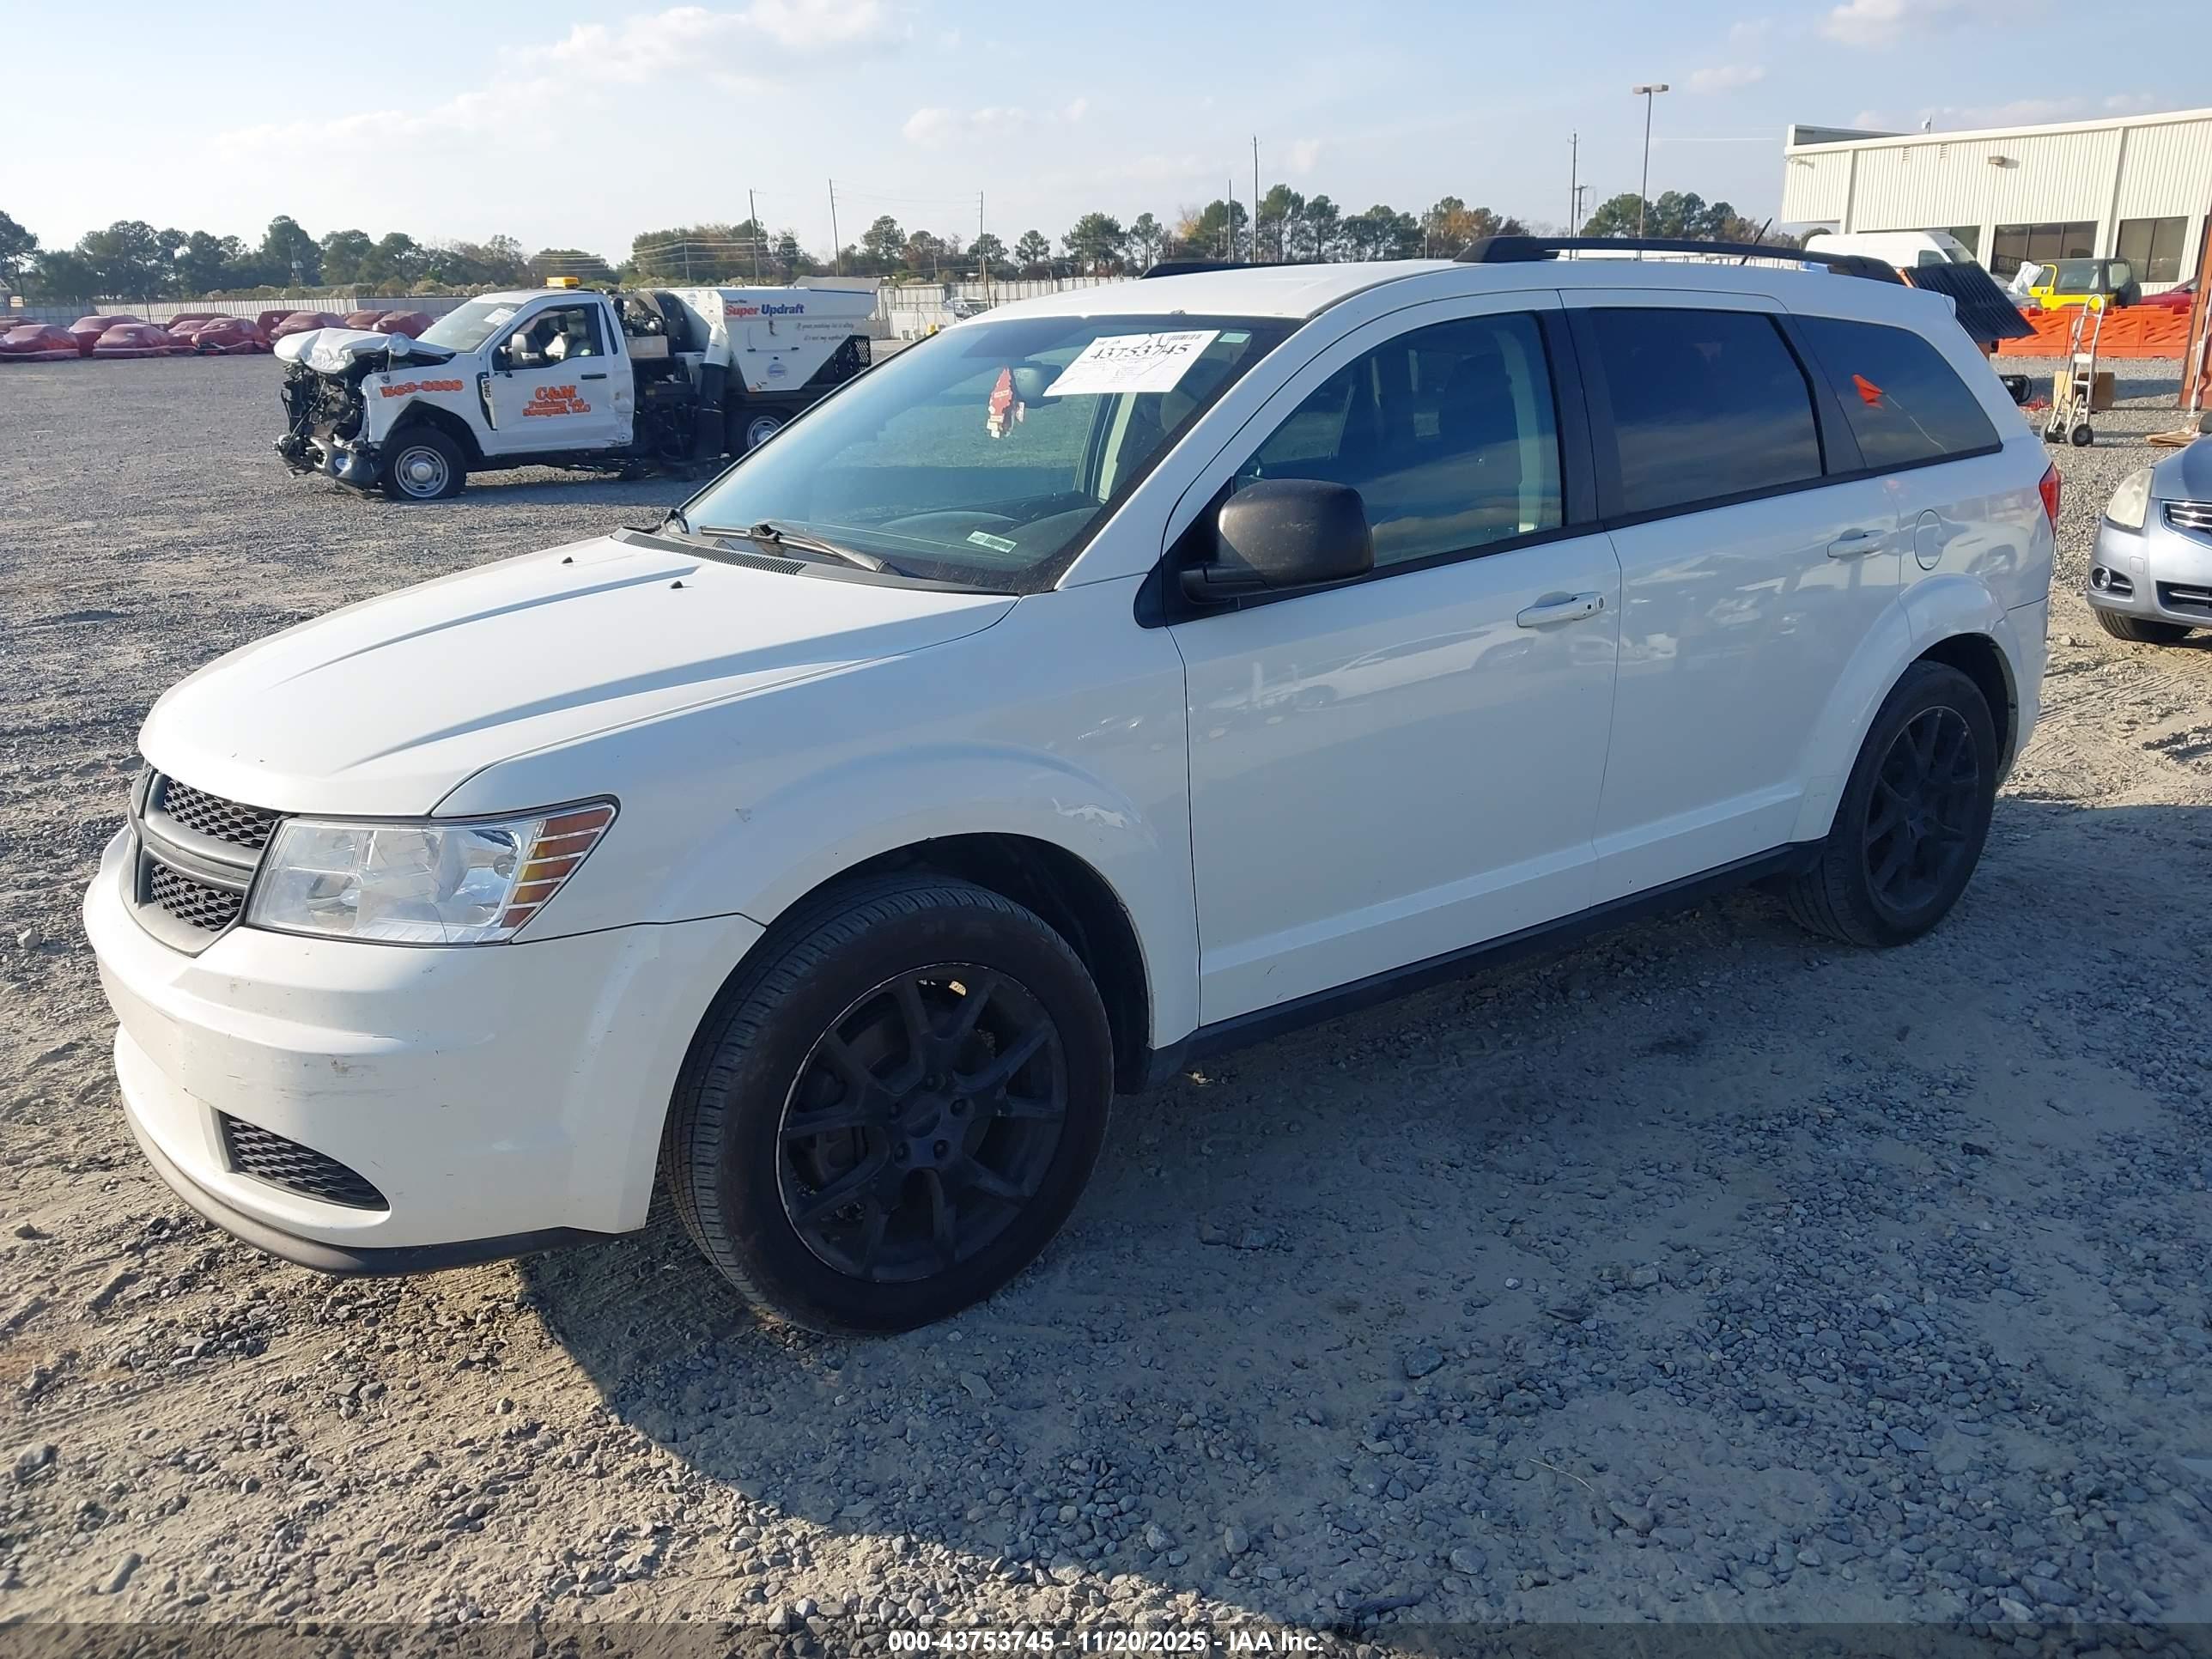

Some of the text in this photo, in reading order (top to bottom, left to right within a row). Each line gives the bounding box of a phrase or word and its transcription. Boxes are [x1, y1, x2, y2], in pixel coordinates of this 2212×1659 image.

[726, 303, 805, 317] Super Updraft
[1091, 343, 1192, 359] 43753745
[535, 385, 577, 401] C&M
